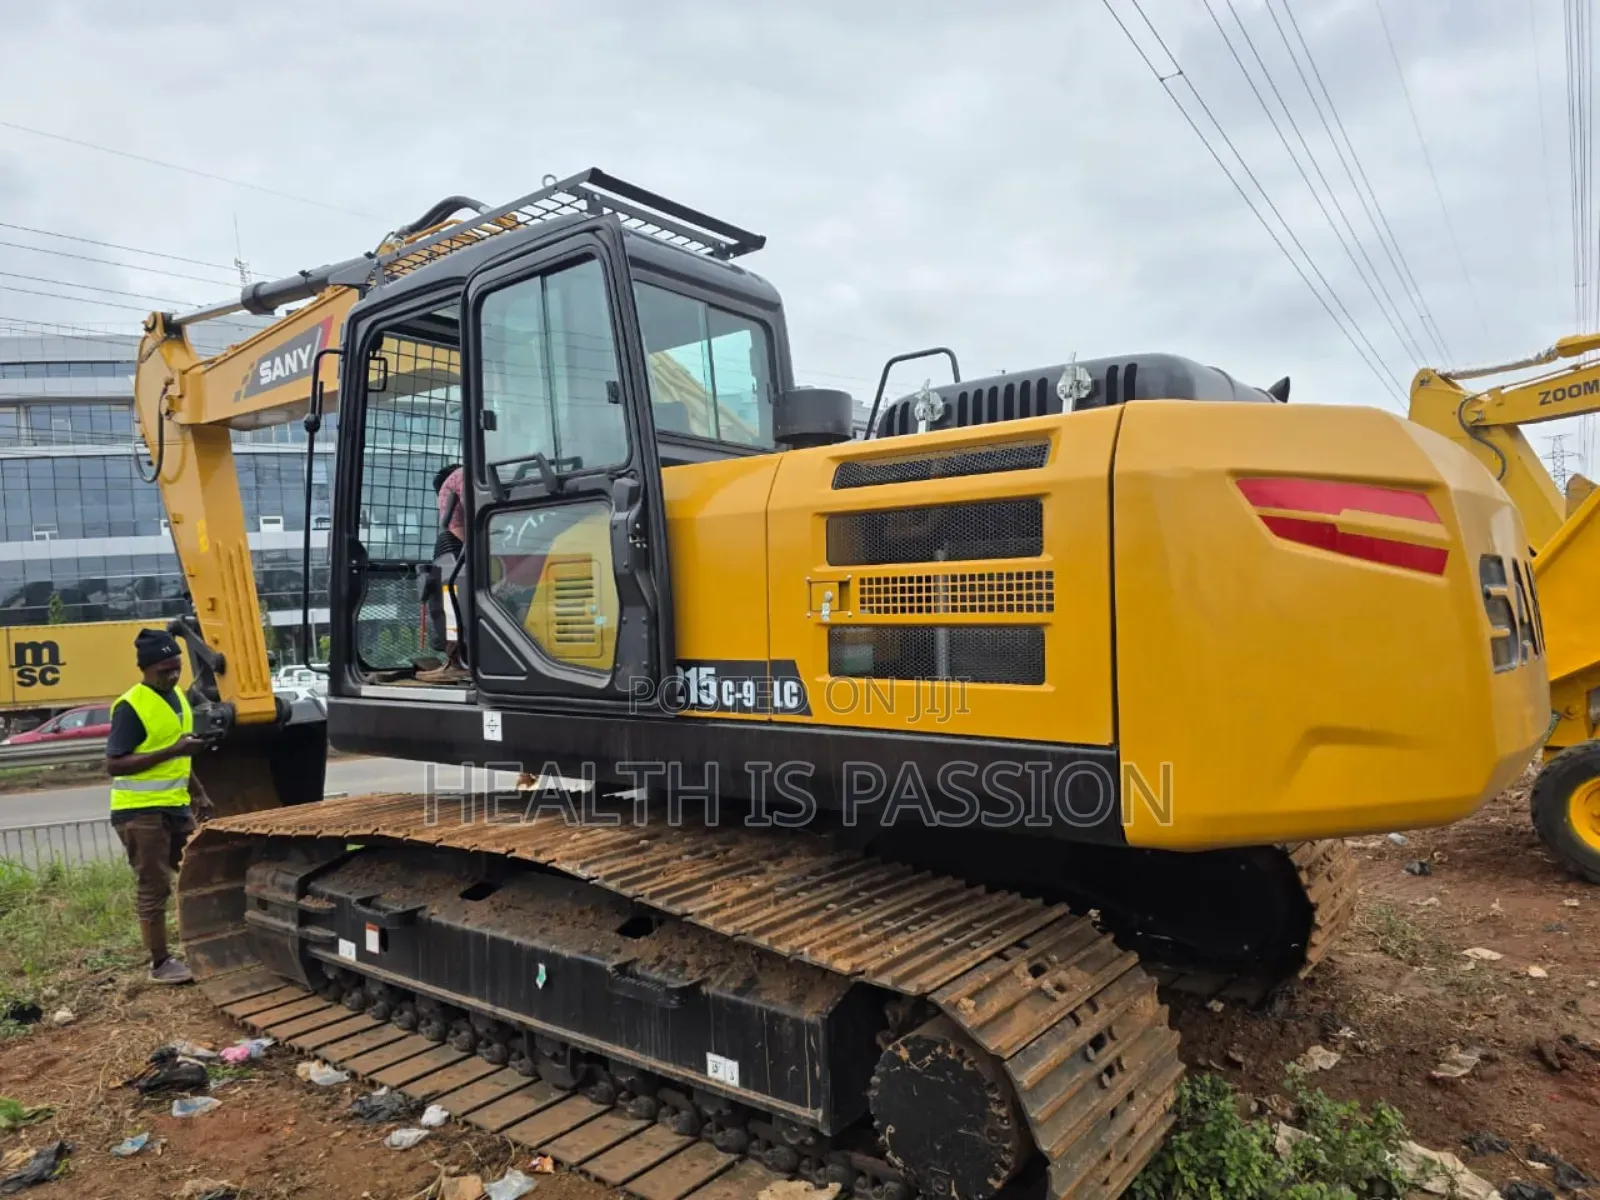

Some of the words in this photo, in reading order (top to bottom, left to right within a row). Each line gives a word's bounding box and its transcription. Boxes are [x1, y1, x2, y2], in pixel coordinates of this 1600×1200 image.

[259, 343, 312, 386] SANY
[1538, 379, 1600, 406] ZOOM
[773, 680, 799, 709] LC
